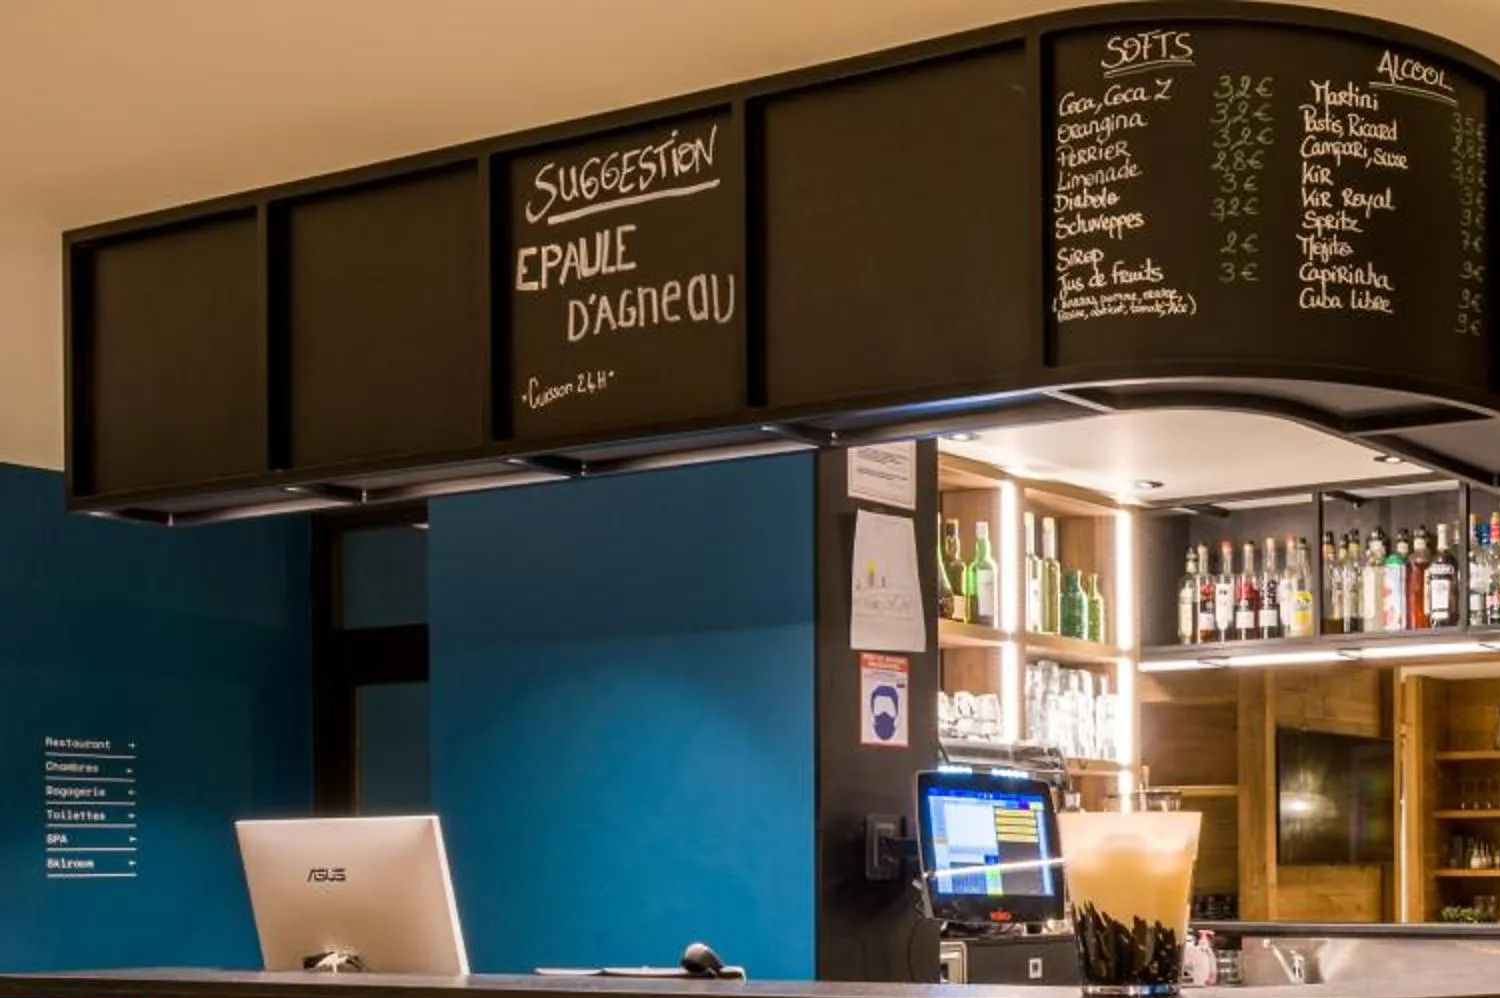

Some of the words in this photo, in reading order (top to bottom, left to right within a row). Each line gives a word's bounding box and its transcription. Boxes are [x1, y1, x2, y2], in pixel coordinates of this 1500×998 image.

[1101, 31, 1193, 68] SOFTS
[1377, 50, 1455, 92] ALCOOL
[1104, 84, 1150, 106] Coca
[1309, 79, 1379, 111] Martini
[1348, 113, 1397, 141] Ricard
[525, 124, 717, 223] SUGGESTION
[1057, 157, 1143, 191] Limonade
[1054, 186, 1121, 213] Diabolo
[1342, 186, 1397, 218] Royal
[1055, 211, 1145, 240] Schweppes
[1302, 209, 1365, 237] Spritz
[515, 225, 637, 292] EPAULE
[1058, 274, 1084, 299] Jus
[1088, 266, 1107, 287] de
[1300, 286, 1344, 309] Cuba
[45, 736, 111, 750] Restaurant
[45, 761, 99, 773] Chambres
[46, 809, 106, 822] Toilettes
[46, 834, 68, 845] SPA
[307, 868, 346, 882] ASUS
